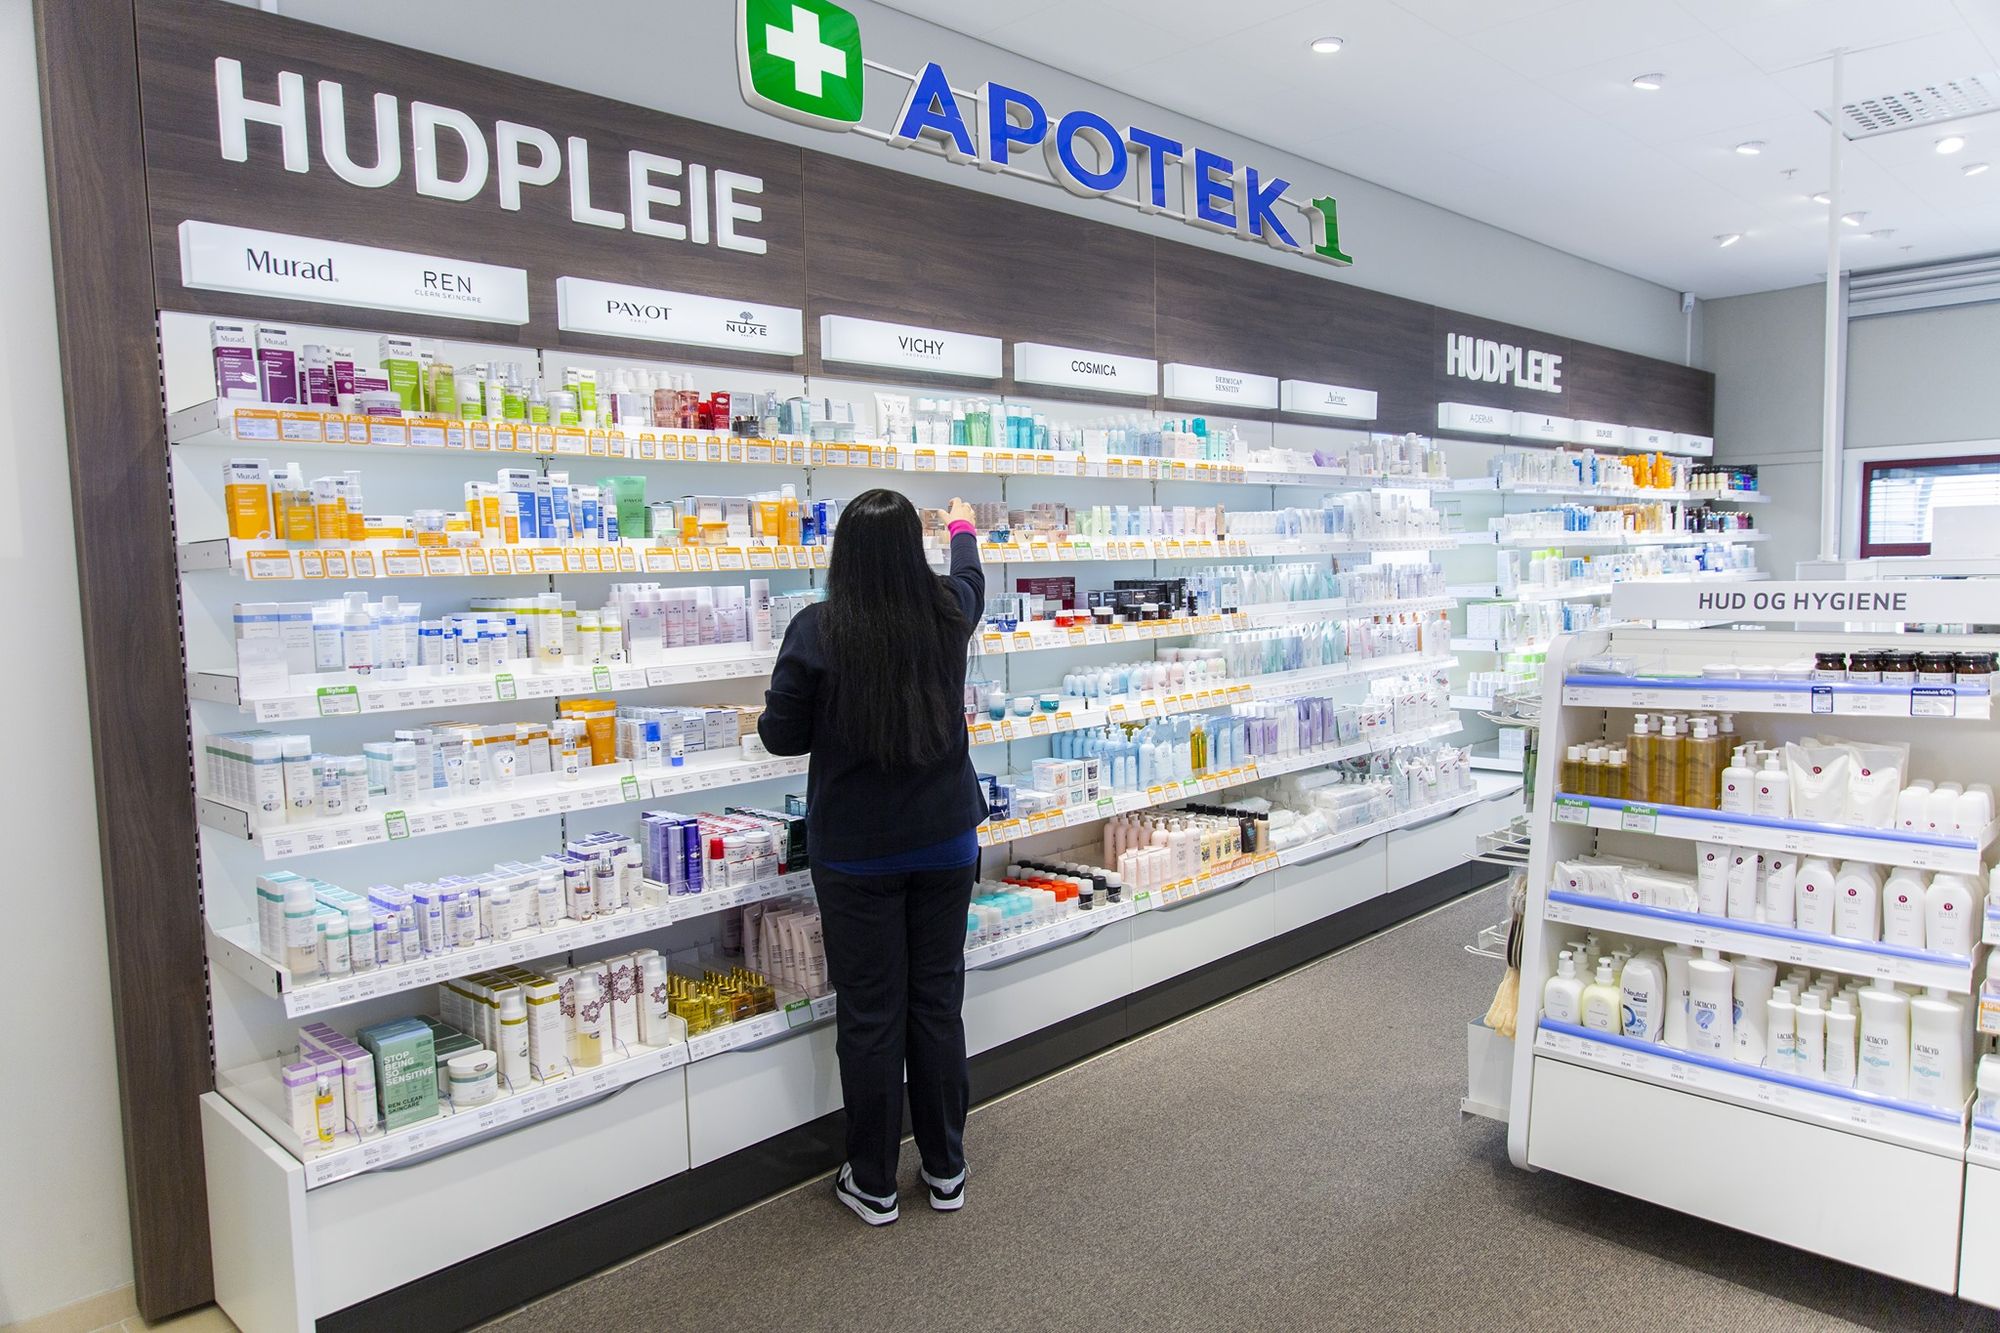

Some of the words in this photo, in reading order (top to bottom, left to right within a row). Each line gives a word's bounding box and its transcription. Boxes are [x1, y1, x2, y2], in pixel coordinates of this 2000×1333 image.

[215, 56, 768, 255] HUDPLEIE
[893, 61, 1299, 248] APOTEK
[1303, 195, 1354, 267] 1
[423, 270, 472, 294] REN
[414, 289, 440, 298] CLEAN
[442, 293, 482, 304] SKINCARE
[607, 300, 672, 320] PAYOT
[726, 323, 768, 336] NUXE
[898, 336, 944, 355] VICHY
[1071, 360, 1117, 377] COSMICA
[1446, 332, 1563, 394] HUDPLEIE
[1700, 593, 1746, 609] HUD
[1754, 593, 1786, 610] OG
[1794, 592, 1907, 610] HYGIENE
[1623, 987, 1648, 998] Neutral
[1694, 1000, 1717, 1010] LACTACYD
[1864, 1034, 1888, 1046] LACTACYD
[1914, 1042, 1939, 1056] LACTACYD
[383, 1050, 409, 1064] STOP
[384, 1057, 415, 1071] BEING
[385, 1069, 400, 1080] SO
[385, 1066, 434, 1087] SENSITIVE
[387, 1101, 401, 1109] REN
[402, 1095, 423, 1105] CLEAN
[387, 1102, 420, 1114] SKINCARE
